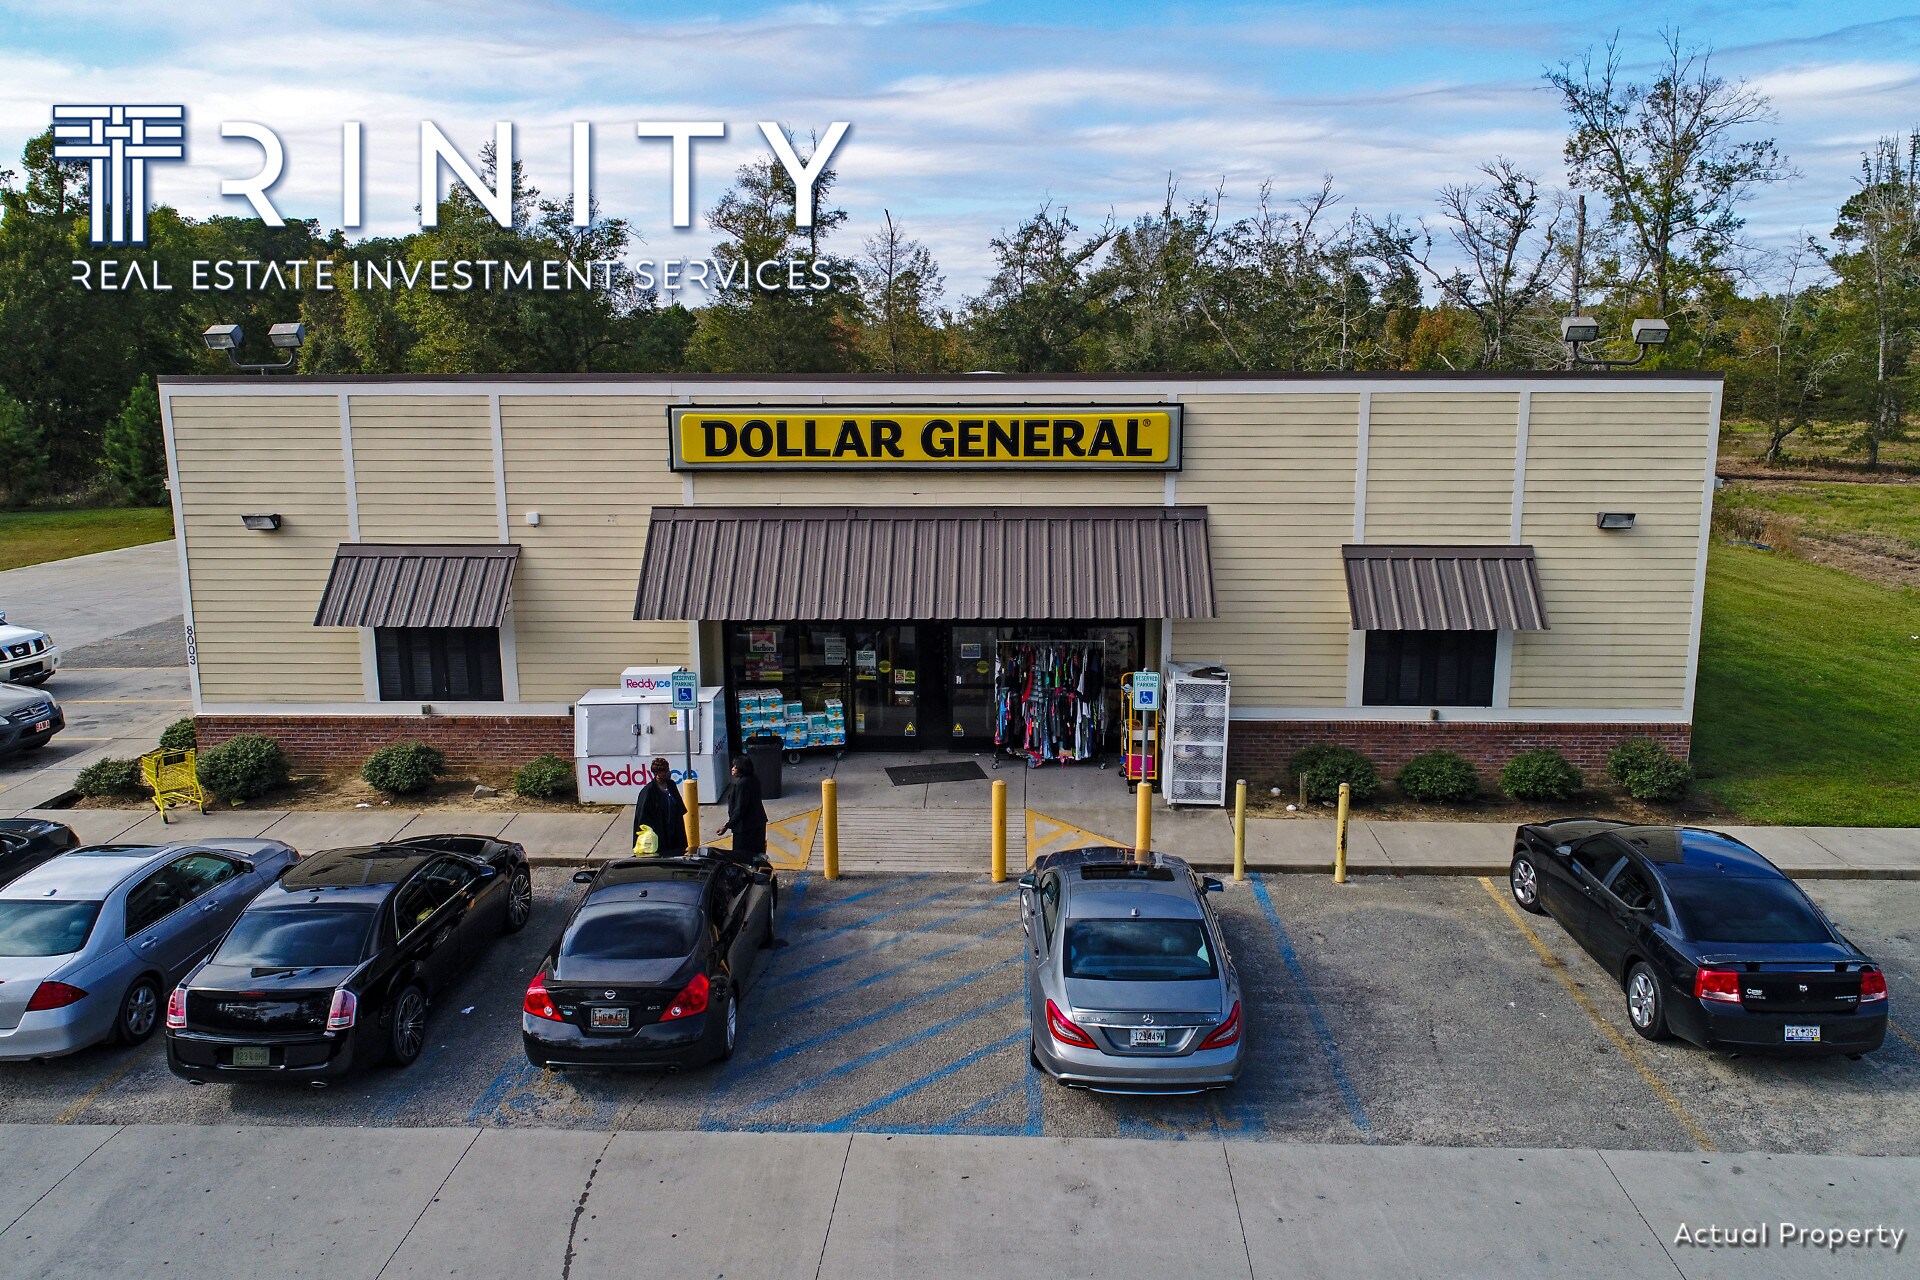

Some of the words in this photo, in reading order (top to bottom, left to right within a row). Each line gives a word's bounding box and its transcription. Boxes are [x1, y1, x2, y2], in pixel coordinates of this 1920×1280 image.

[700, 419, 905, 458] DOLLAR
[920, 418, 1153, 458] GENERAL
[185, 625, 196, 665] 8003
[1786, 1028, 1800, 1037] PEK
[1805, 1028, 1818, 1037] 353
